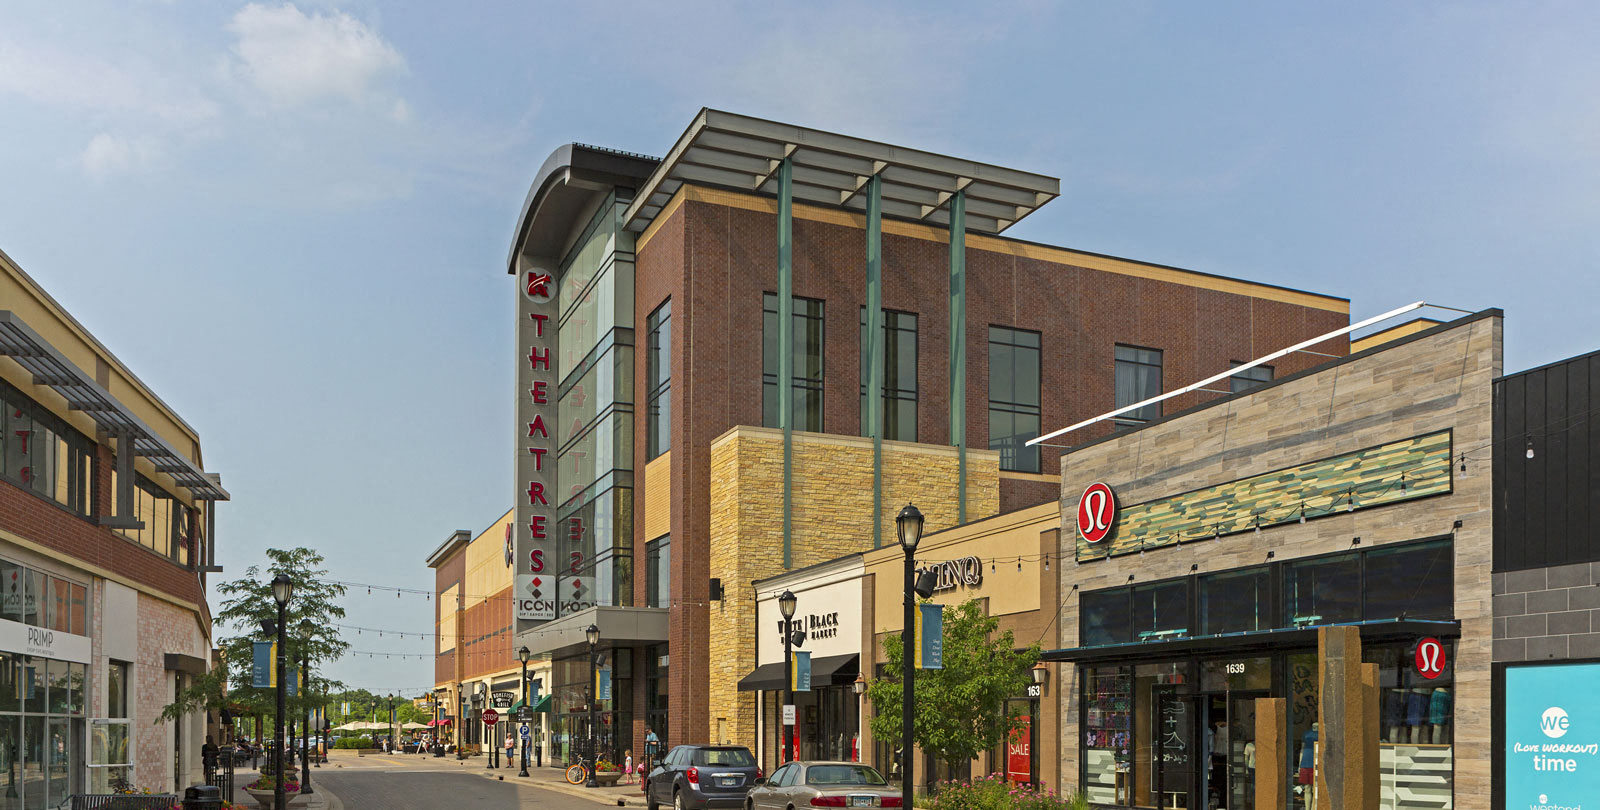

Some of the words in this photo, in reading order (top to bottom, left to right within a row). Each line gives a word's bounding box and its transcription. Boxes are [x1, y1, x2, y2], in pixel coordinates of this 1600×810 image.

[525, 313, 551, 573] THEATRES
[519, 599, 554, 612] ICON
[777, 619, 803, 634] WTE
[809, 611, 839, 629] BLACK
[28, 627, 54, 648] PRIMP
[811, 628, 838, 641] MARKET
[1225, 663, 1245, 674] 1639
[483, 713, 498, 722] STOP
[1540, 715, 1570, 731] we
[1010, 743, 1029, 757] SALE
[1542, 743, 1598, 755] WORKOUT)
[1533, 755, 1576, 772] time
